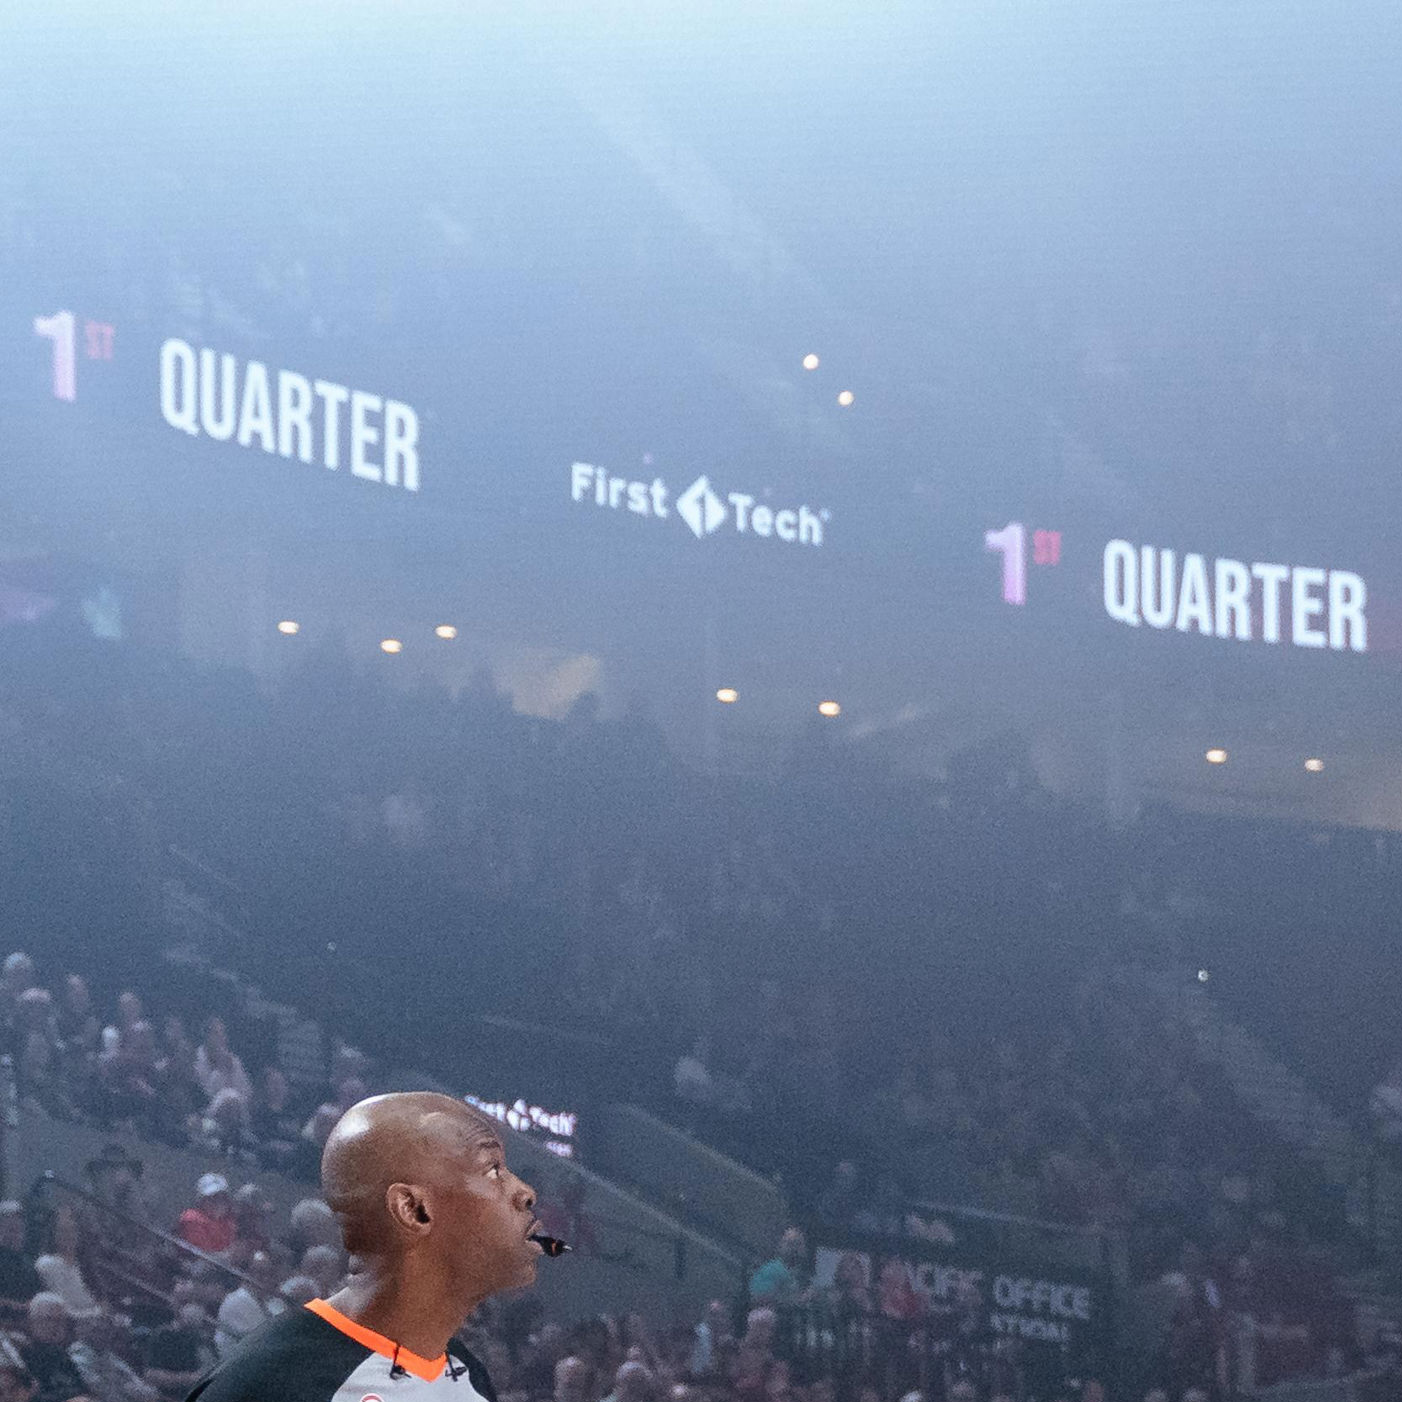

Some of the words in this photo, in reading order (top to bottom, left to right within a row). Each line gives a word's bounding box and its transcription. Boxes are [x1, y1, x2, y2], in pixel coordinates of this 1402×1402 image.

[159, 338, 420, 491] QUARTER
[572, 462, 668, 519] First
[1104, 538, 1367, 653] QUARTER
